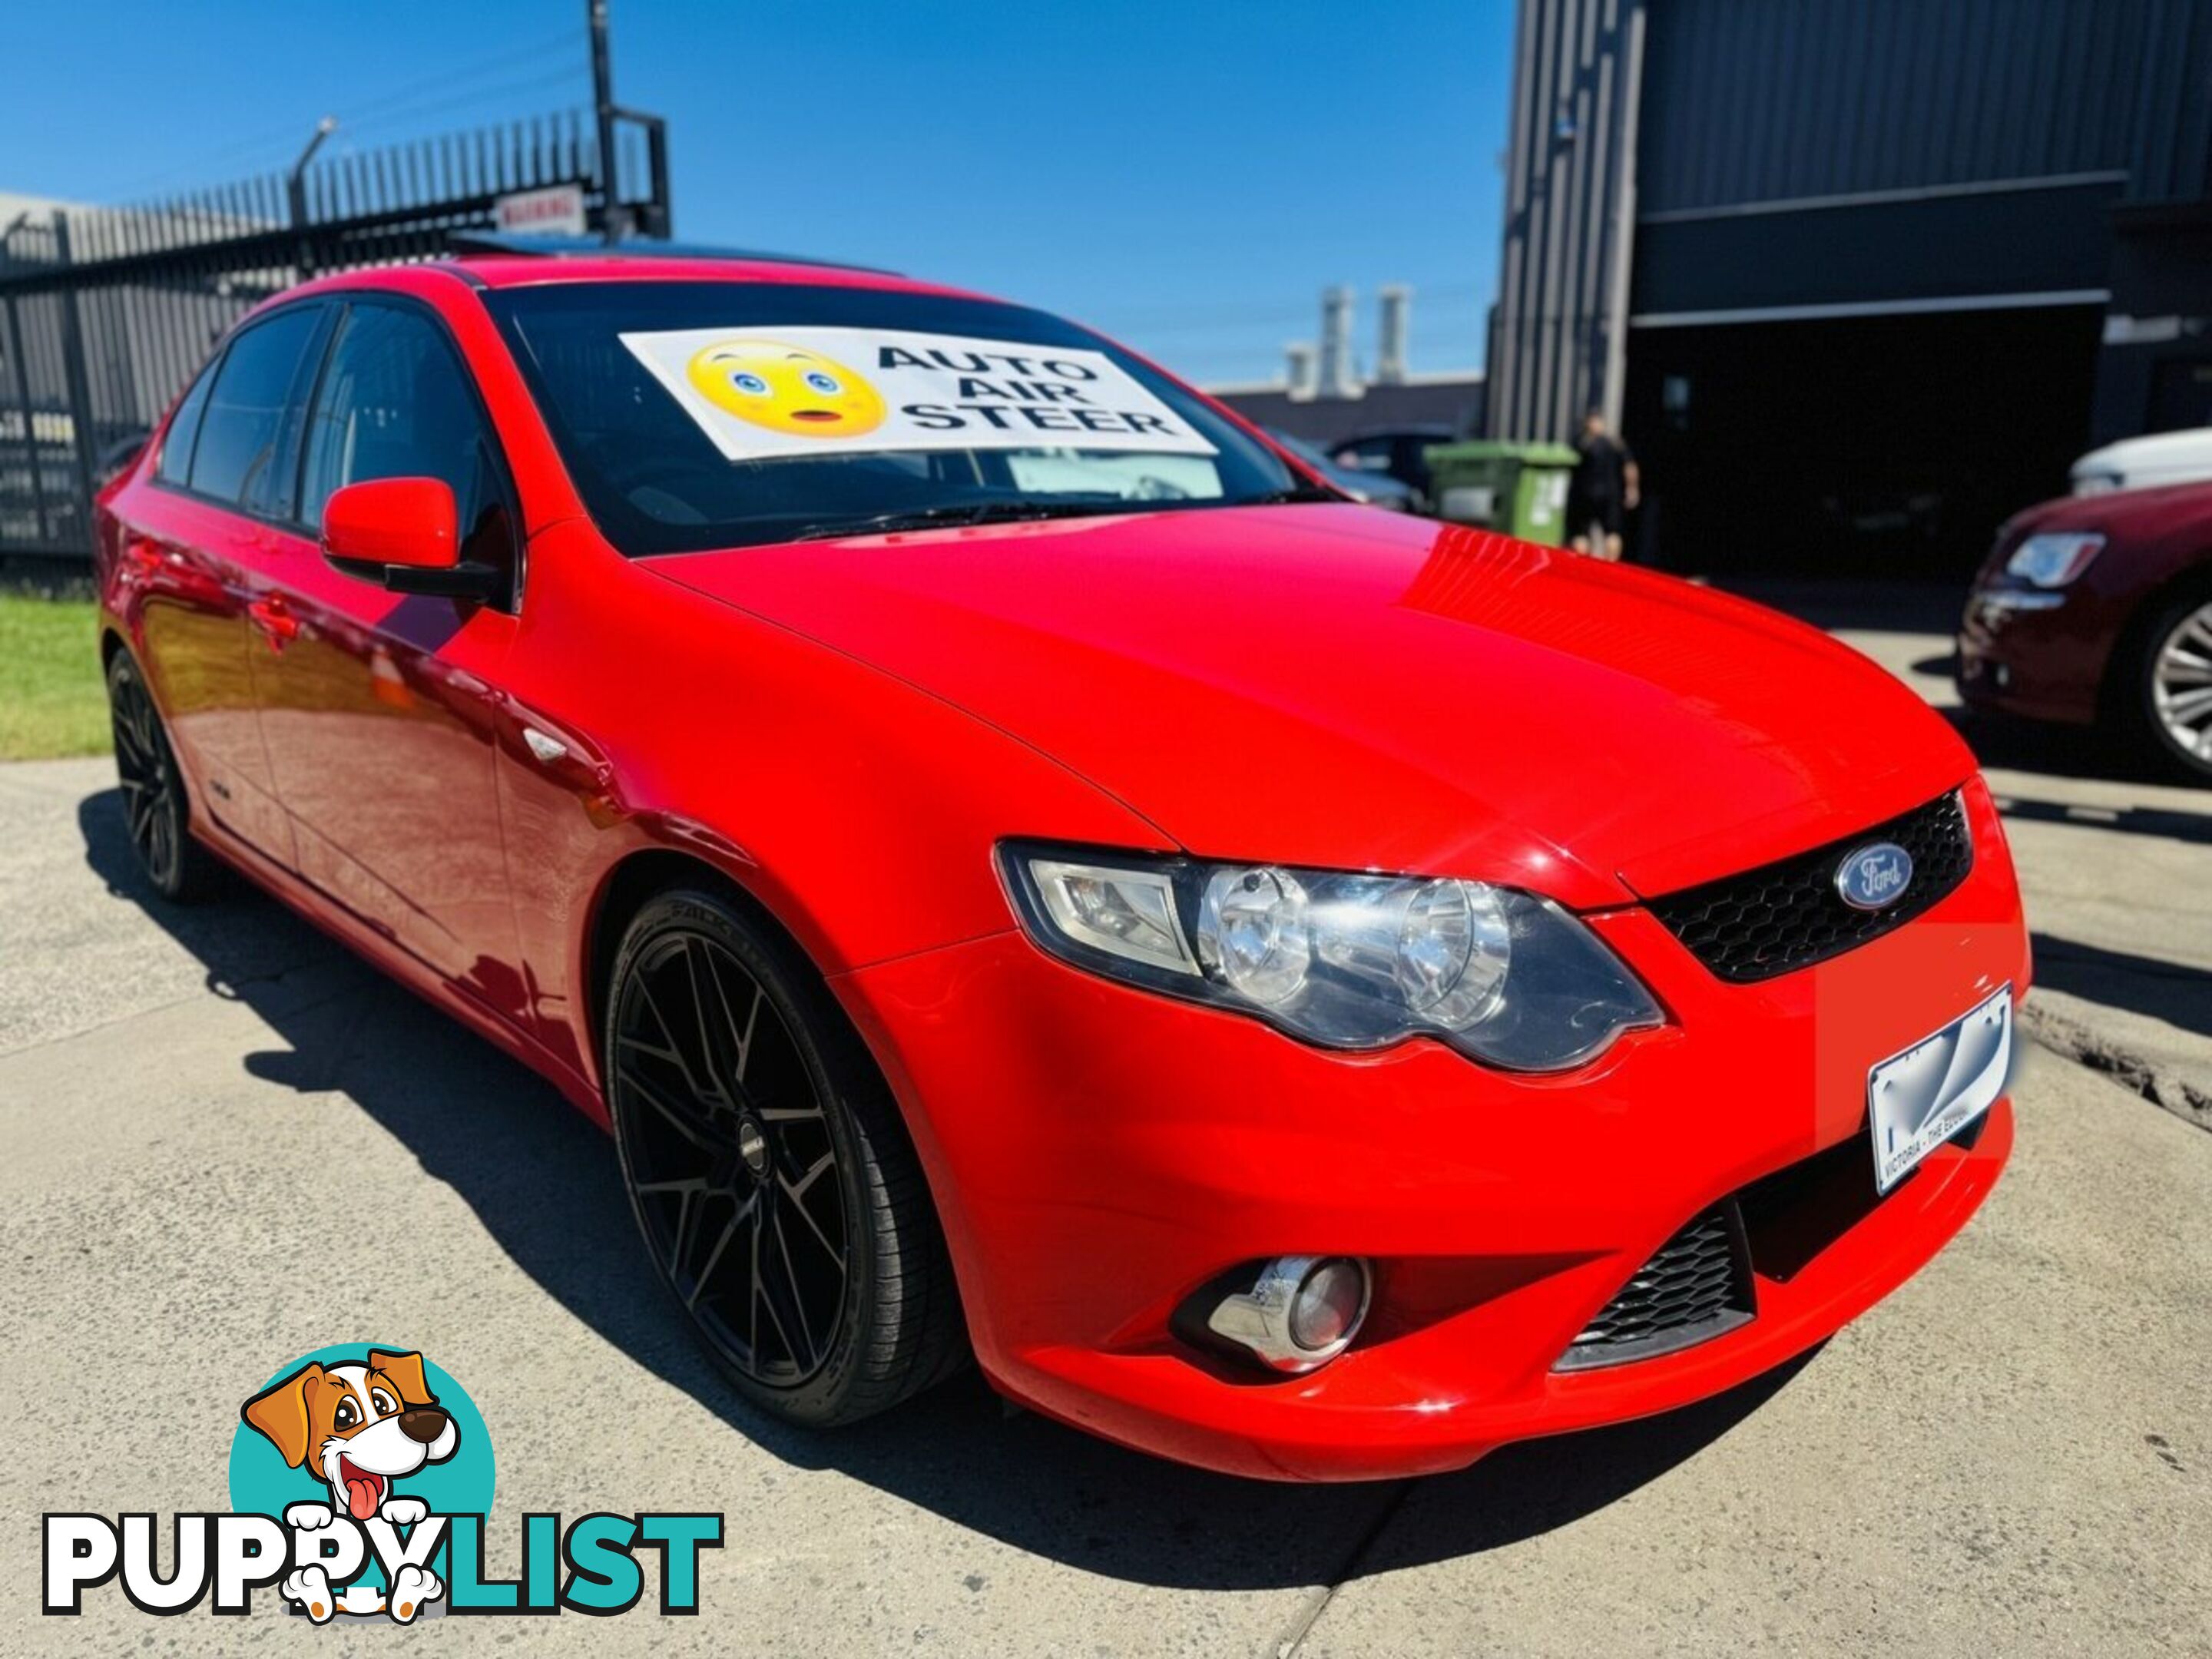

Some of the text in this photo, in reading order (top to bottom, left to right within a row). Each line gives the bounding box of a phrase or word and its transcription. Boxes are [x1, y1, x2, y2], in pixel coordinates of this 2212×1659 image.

[879, 346, 1098, 380] AUTO
[959, 377, 1096, 404] AIR
[901, 403, 1180, 436] STEER
[1861, 854, 1901, 896] Ford
[1885, 1122, 1943, 1177] VICTORIA THE
